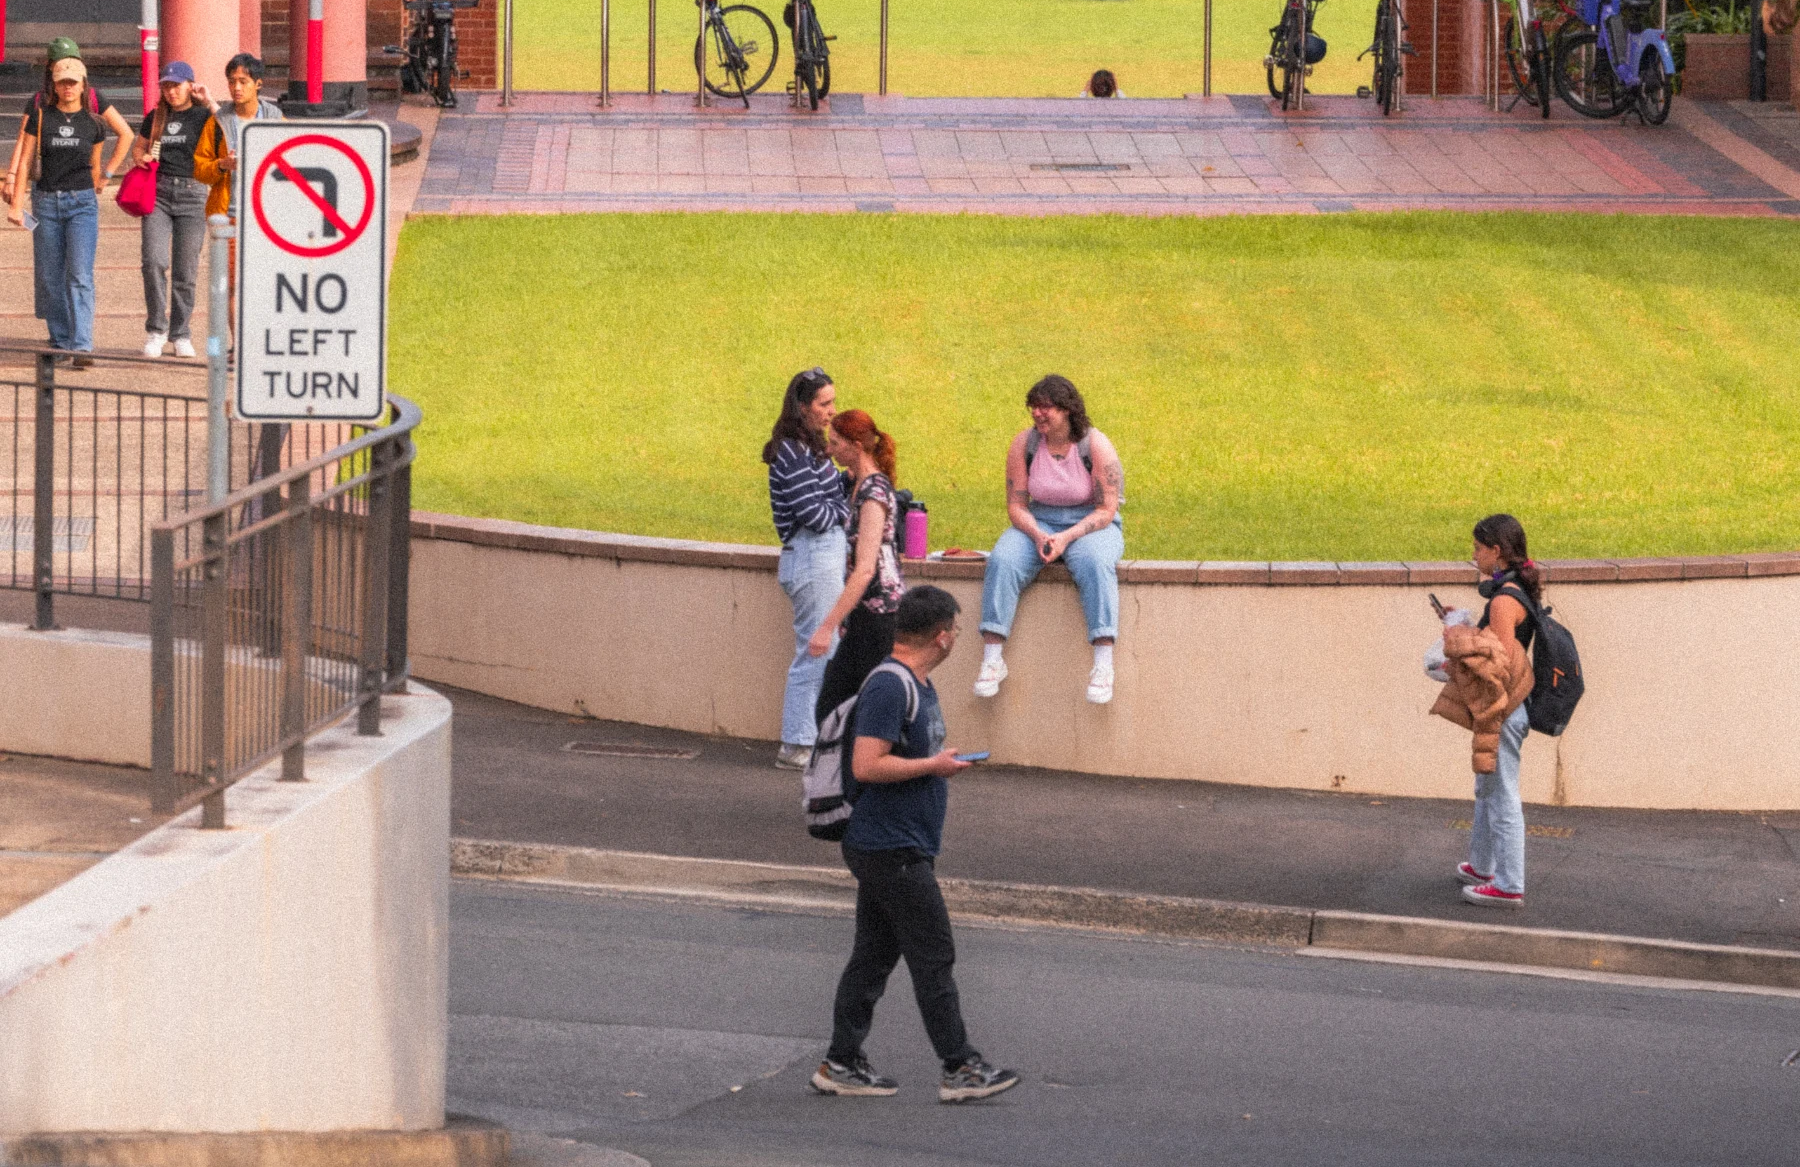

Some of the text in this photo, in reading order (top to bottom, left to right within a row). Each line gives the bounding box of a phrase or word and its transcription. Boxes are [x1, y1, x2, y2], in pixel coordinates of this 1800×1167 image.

[275, 273, 348, 314] NO
[265, 329, 357, 356] LEFT
[263, 371, 359, 399] TURN
